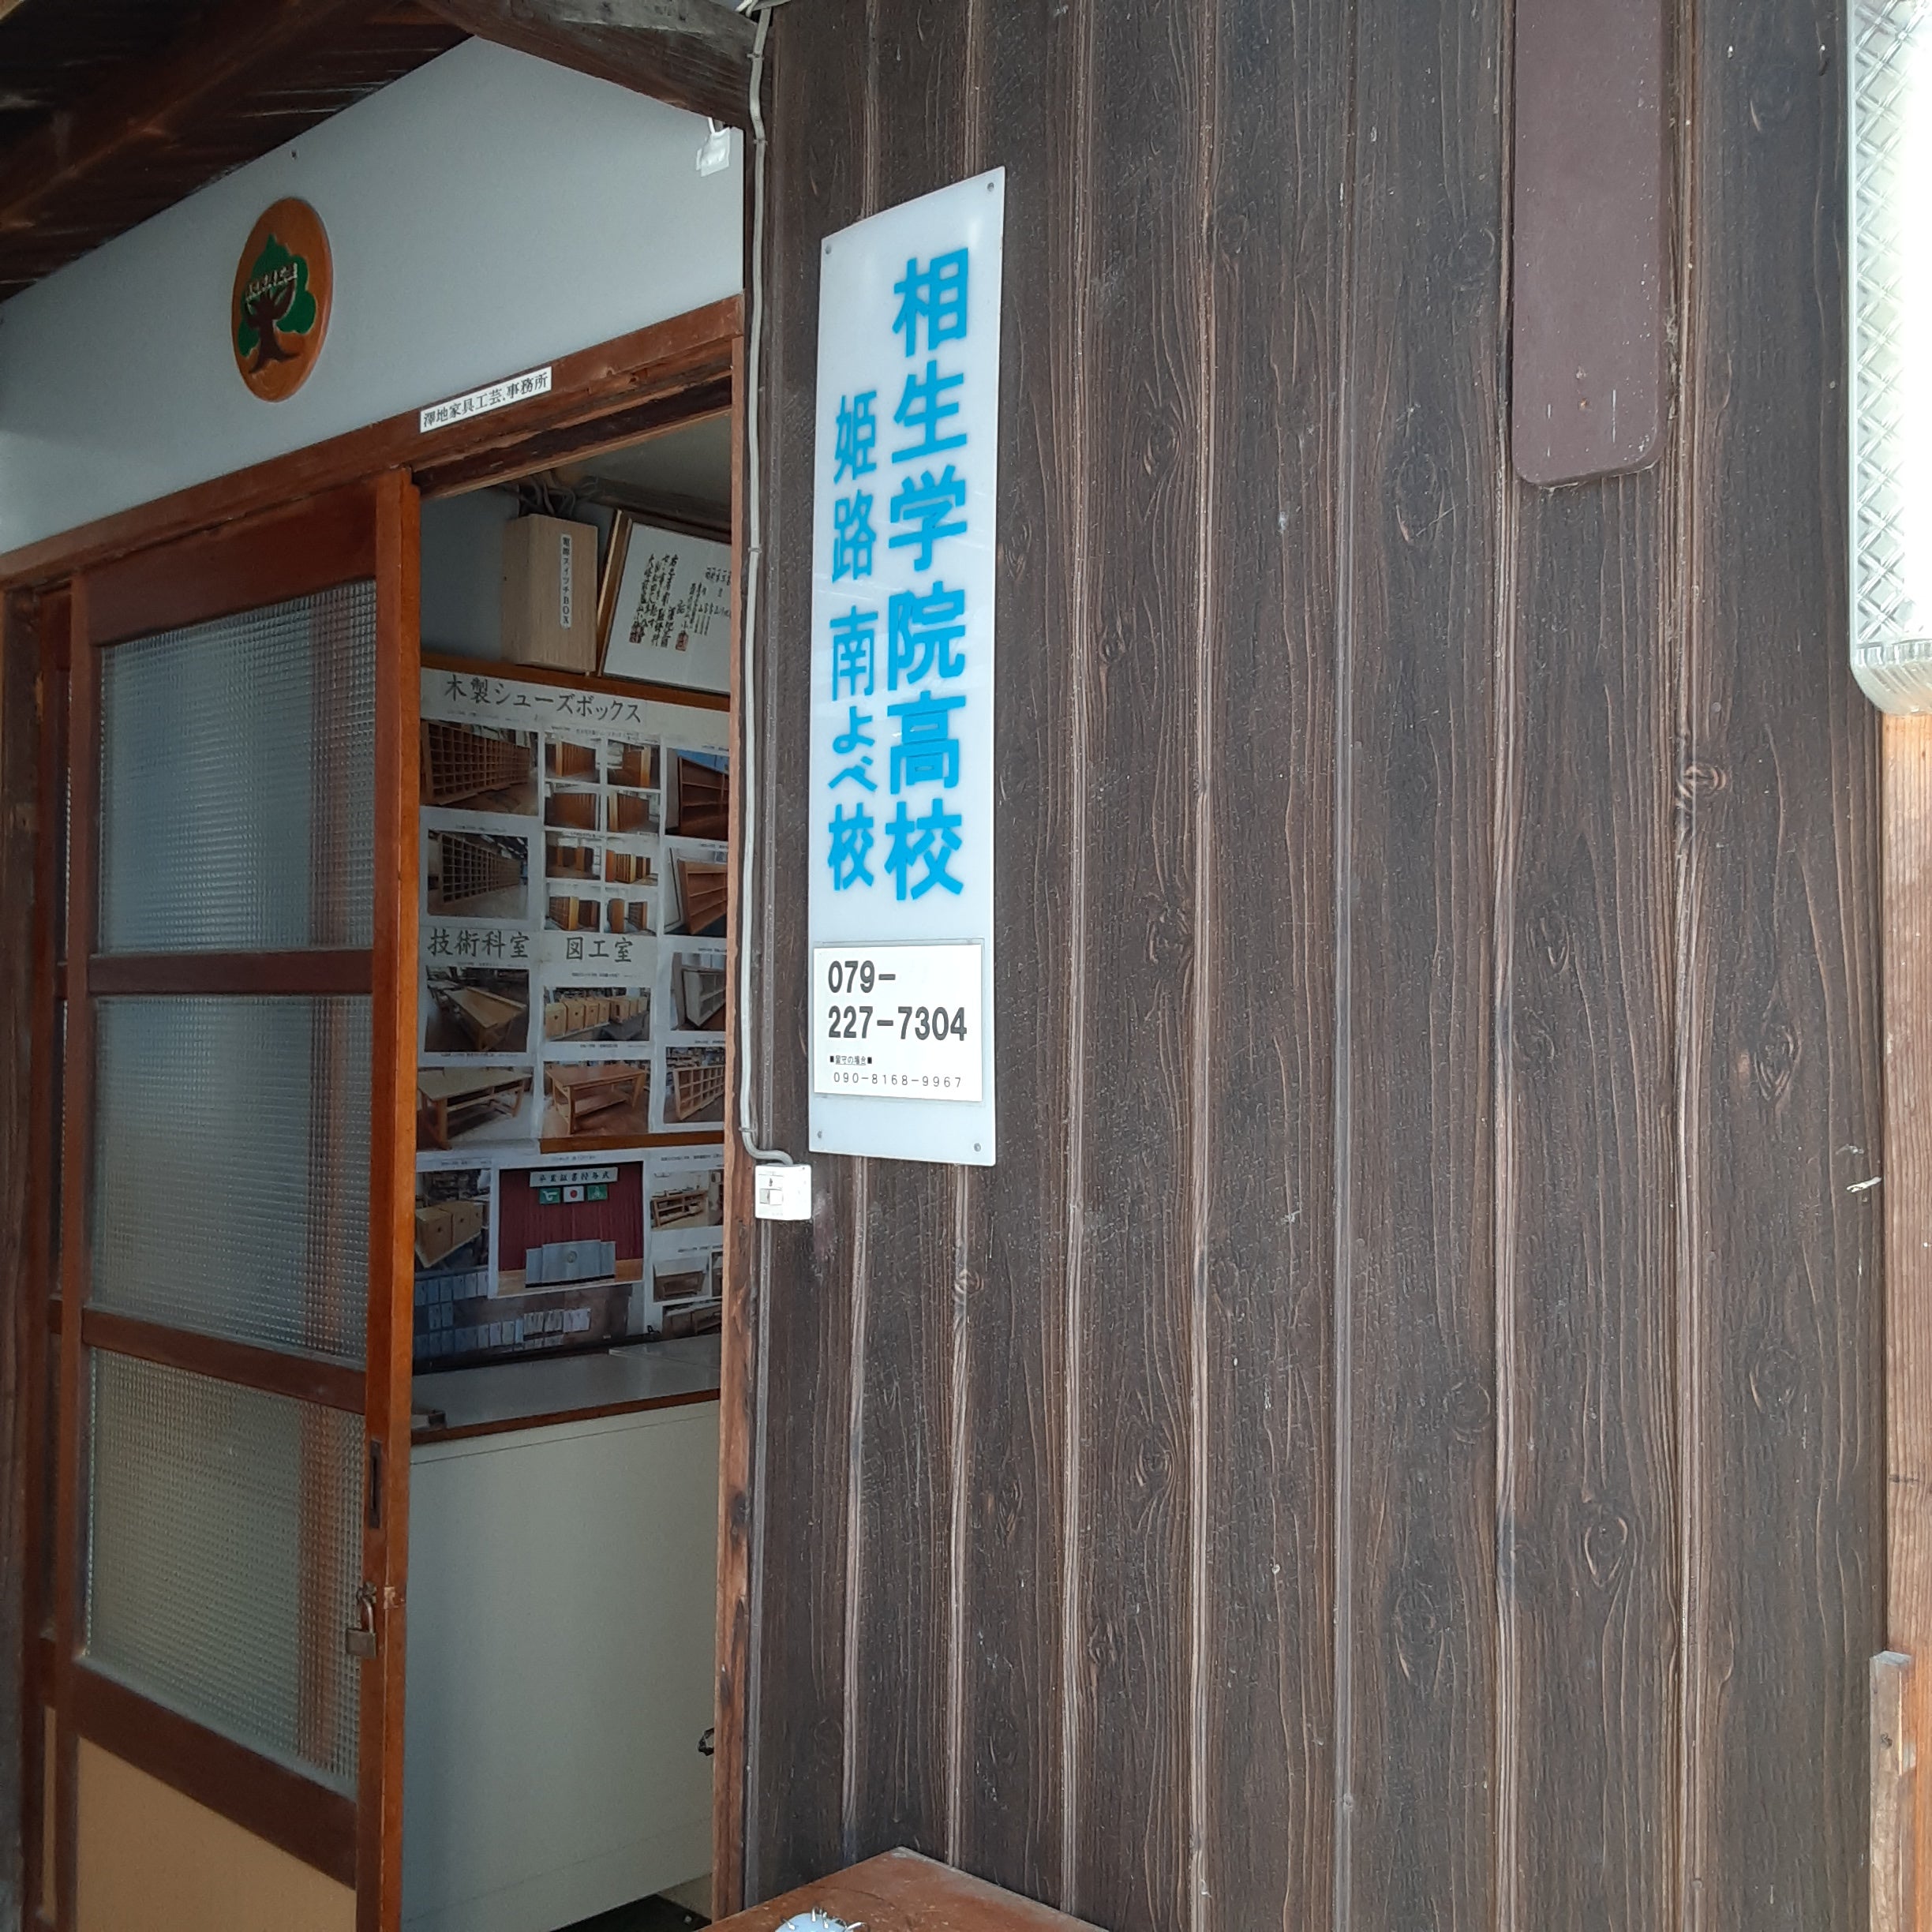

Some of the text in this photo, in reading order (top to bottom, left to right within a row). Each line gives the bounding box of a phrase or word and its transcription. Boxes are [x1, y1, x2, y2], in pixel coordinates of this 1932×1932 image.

[884, 247, 968, 900] 相生学院高校
[444, 674, 641, 723] 木製シューズボックス
[427, 928, 530, 958] 技術科室
[566, 937, 633, 962] 図工室
[828, 960, 896, 993] 079-
[828, 1005, 967, 1041] 227-7304
[833, 1072, 961, 1088] 090-8168-9967
